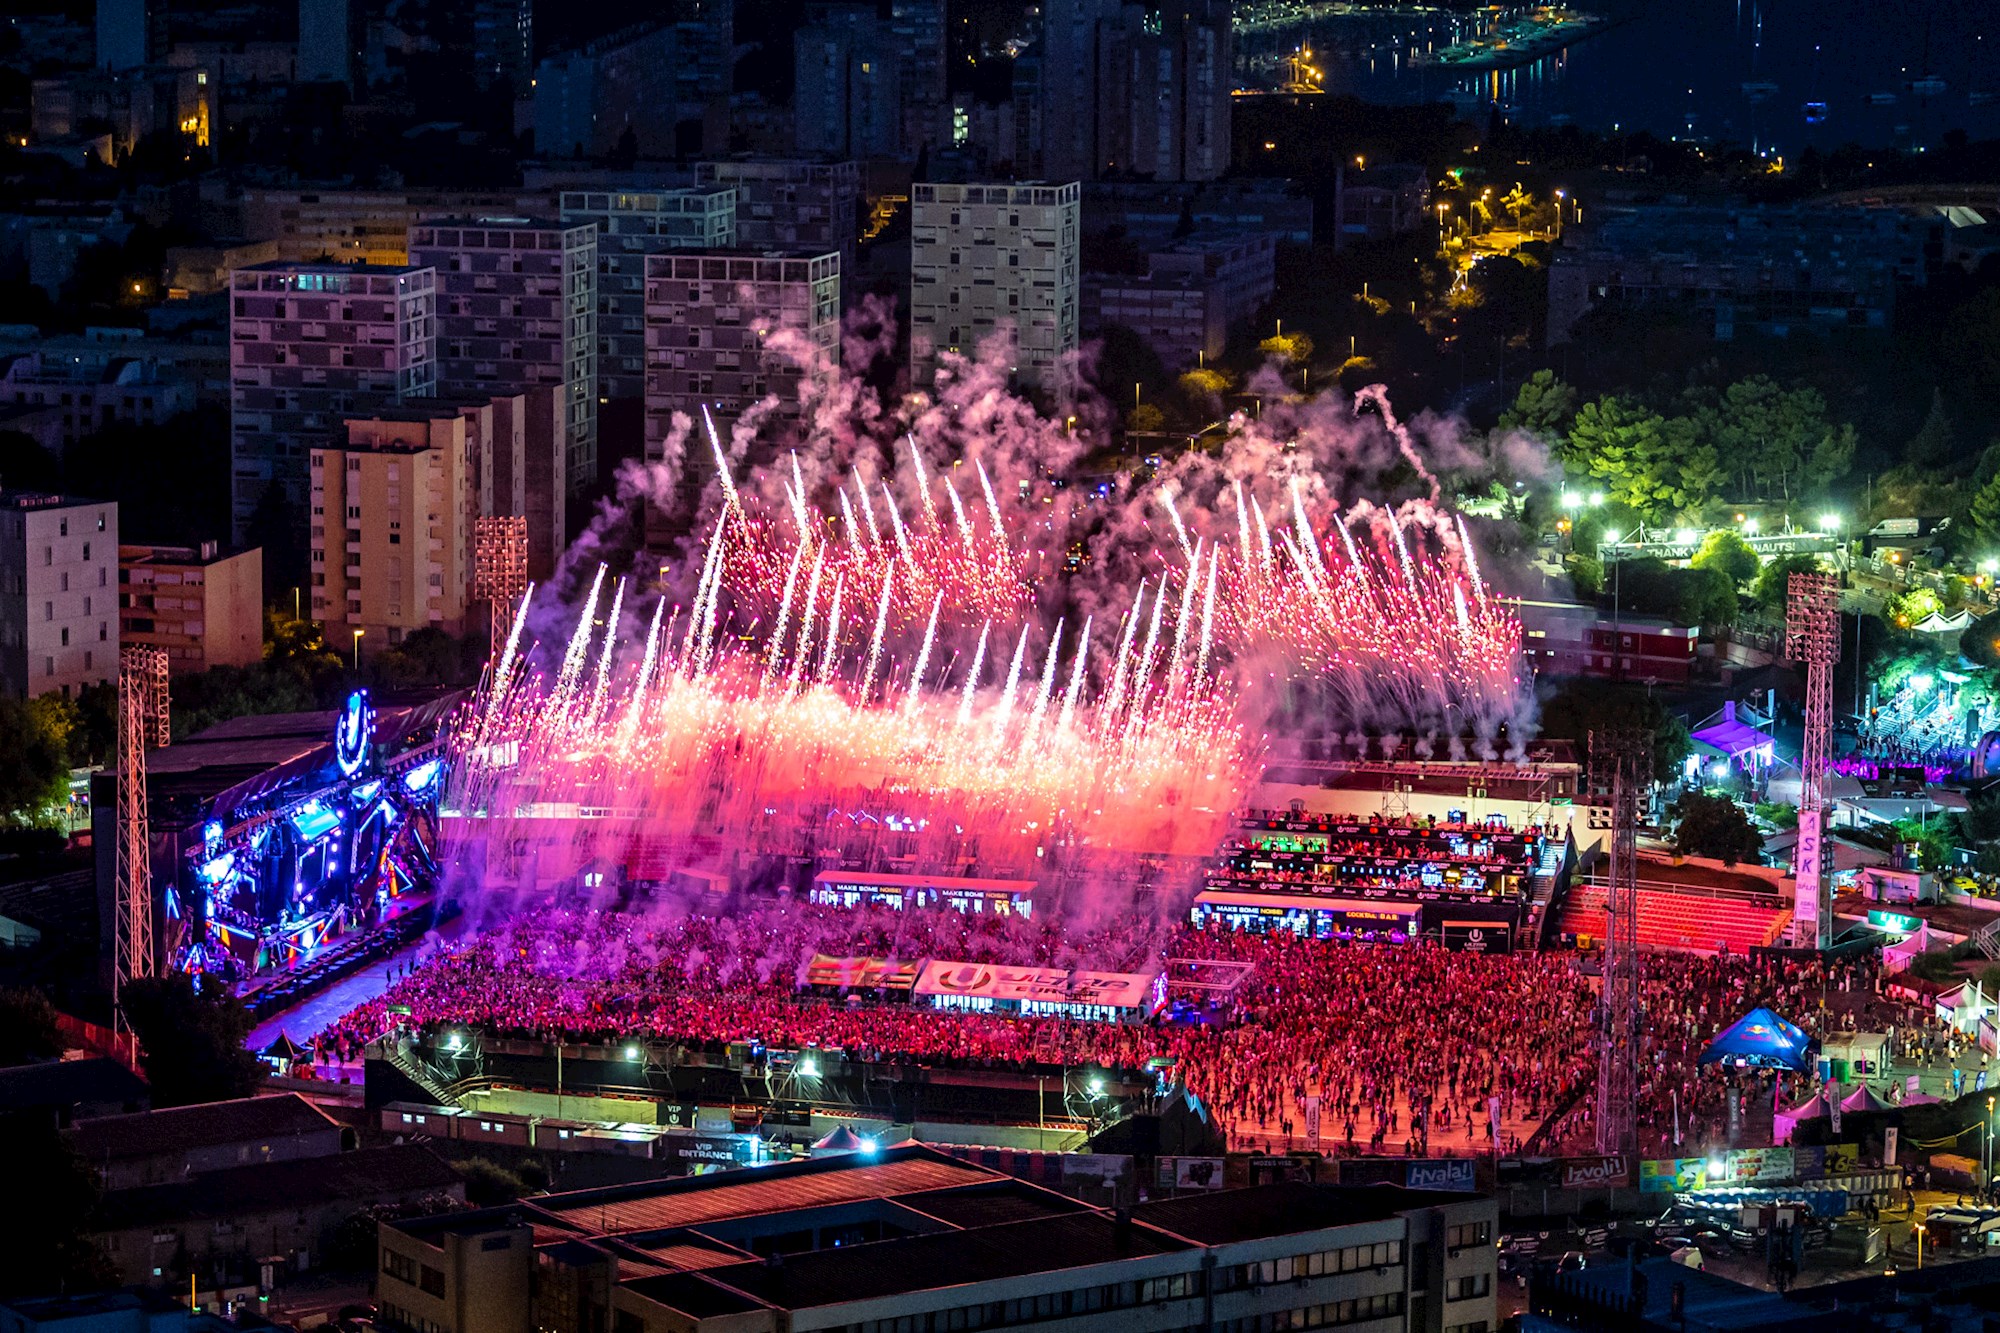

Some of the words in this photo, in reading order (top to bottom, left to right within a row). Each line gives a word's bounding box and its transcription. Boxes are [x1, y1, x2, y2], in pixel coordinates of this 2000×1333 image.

[1647, 547, 1689, 557] THANK
[1751, 542, 1796, 552] NAUTS!
[859, 885, 878, 893] SOME
[1216, 905, 1237, 913] MAKE
[1260, 908, 1283, 916] NOISE!
[695, 1143, 712, 1151] VIP
[679, 1149, 733, 1160] ENTRANCE
[1410, 1161, 1468, 1185] Hvala!
[1568, 1158, 1622, 1181] Izvoli!
